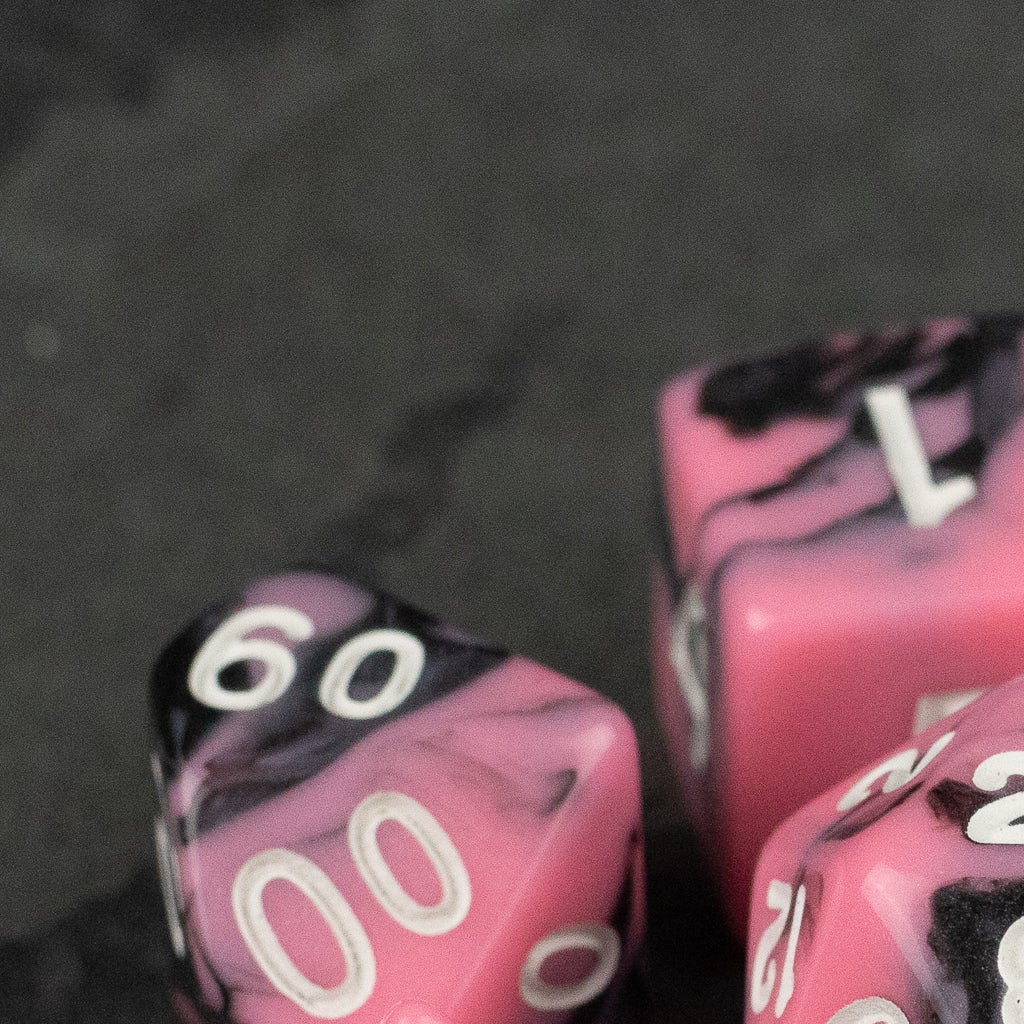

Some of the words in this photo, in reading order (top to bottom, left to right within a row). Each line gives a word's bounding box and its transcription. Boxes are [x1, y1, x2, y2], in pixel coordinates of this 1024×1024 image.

[867, 384, 977, 528] 1
[188, 603, 427, 720] 60
[231, 792, 472, 1019] 00
